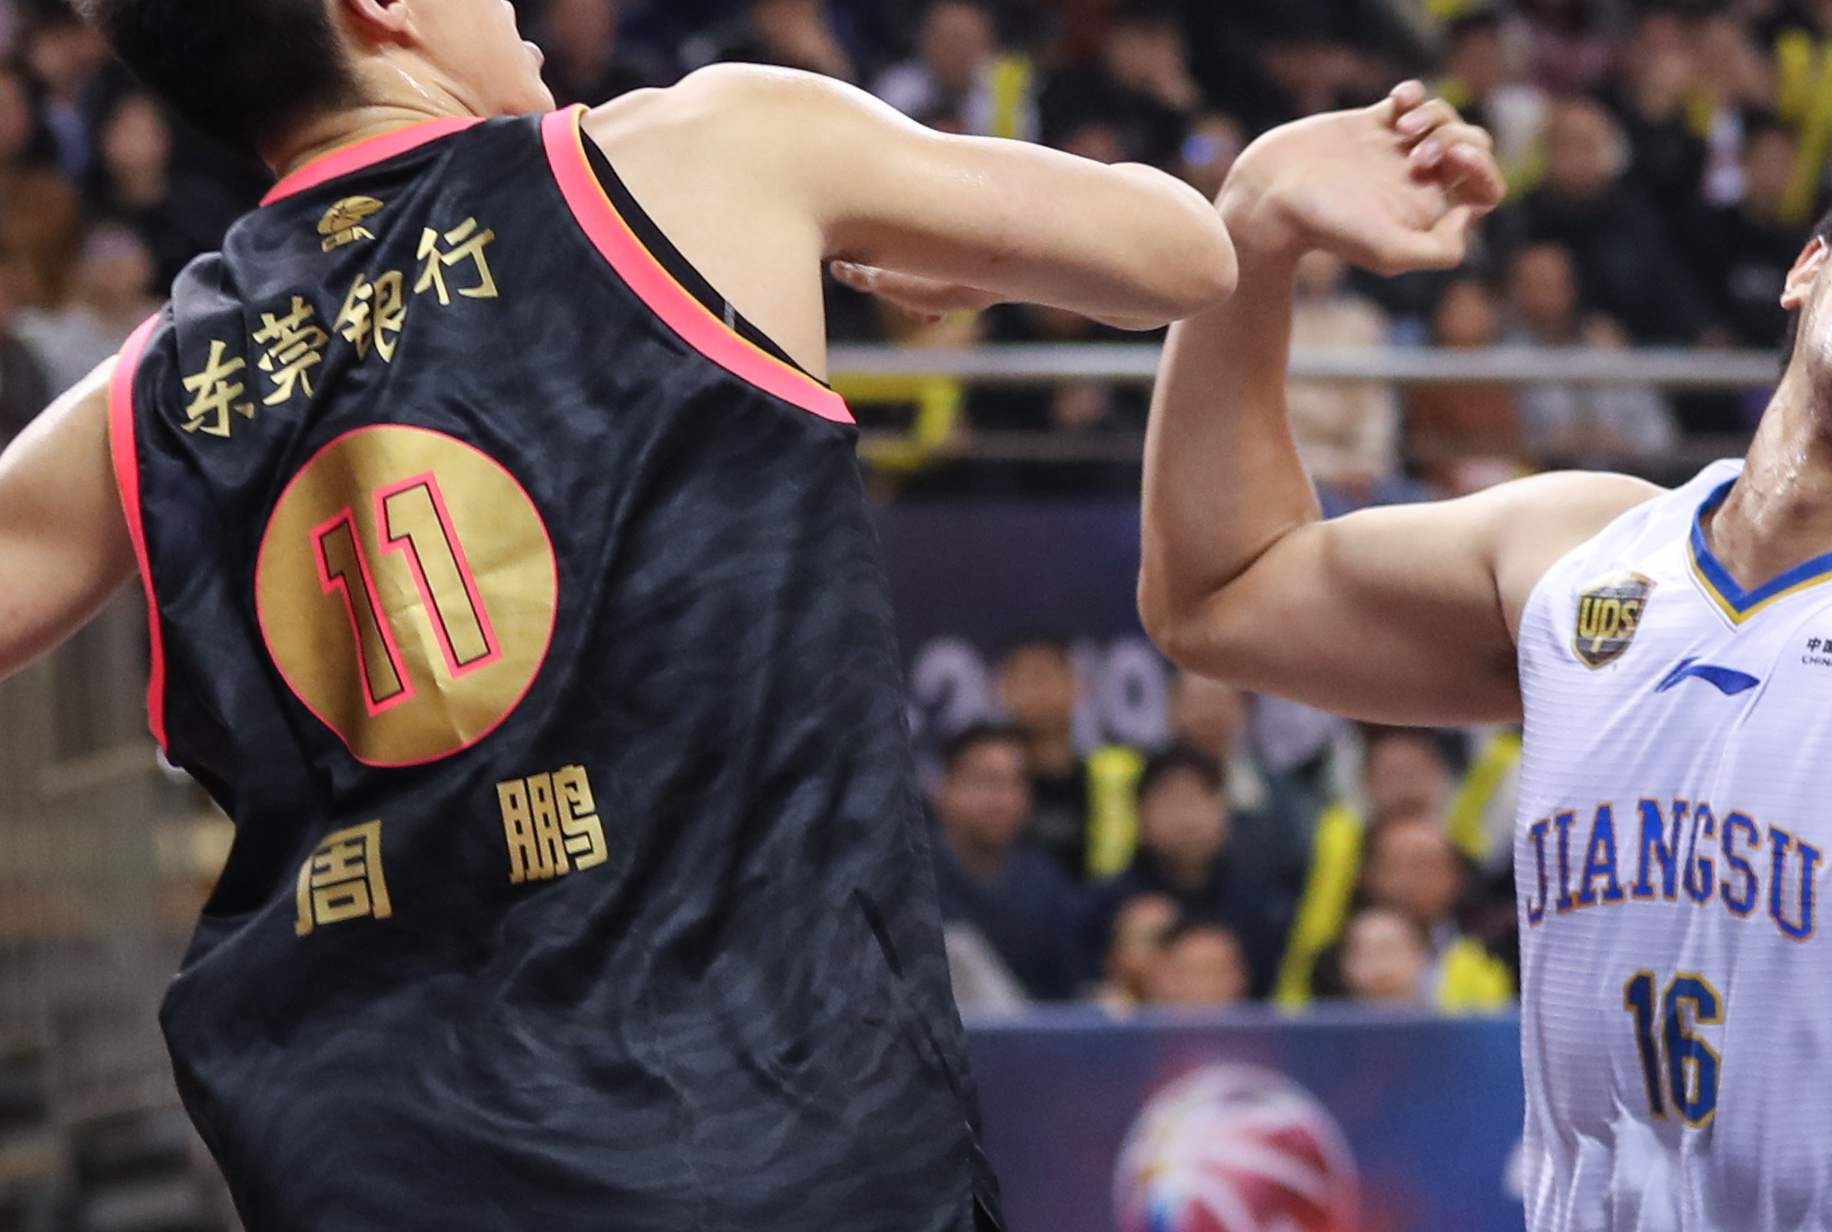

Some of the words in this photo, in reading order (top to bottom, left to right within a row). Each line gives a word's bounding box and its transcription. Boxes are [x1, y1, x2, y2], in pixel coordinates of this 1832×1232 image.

[182, 217, 498, 438] 东莞银行
[310, 471, 501, 717] 11
[1526, 798, 1823, 943] JIANGSU
[1623, 970, 1723, 1129] 16
